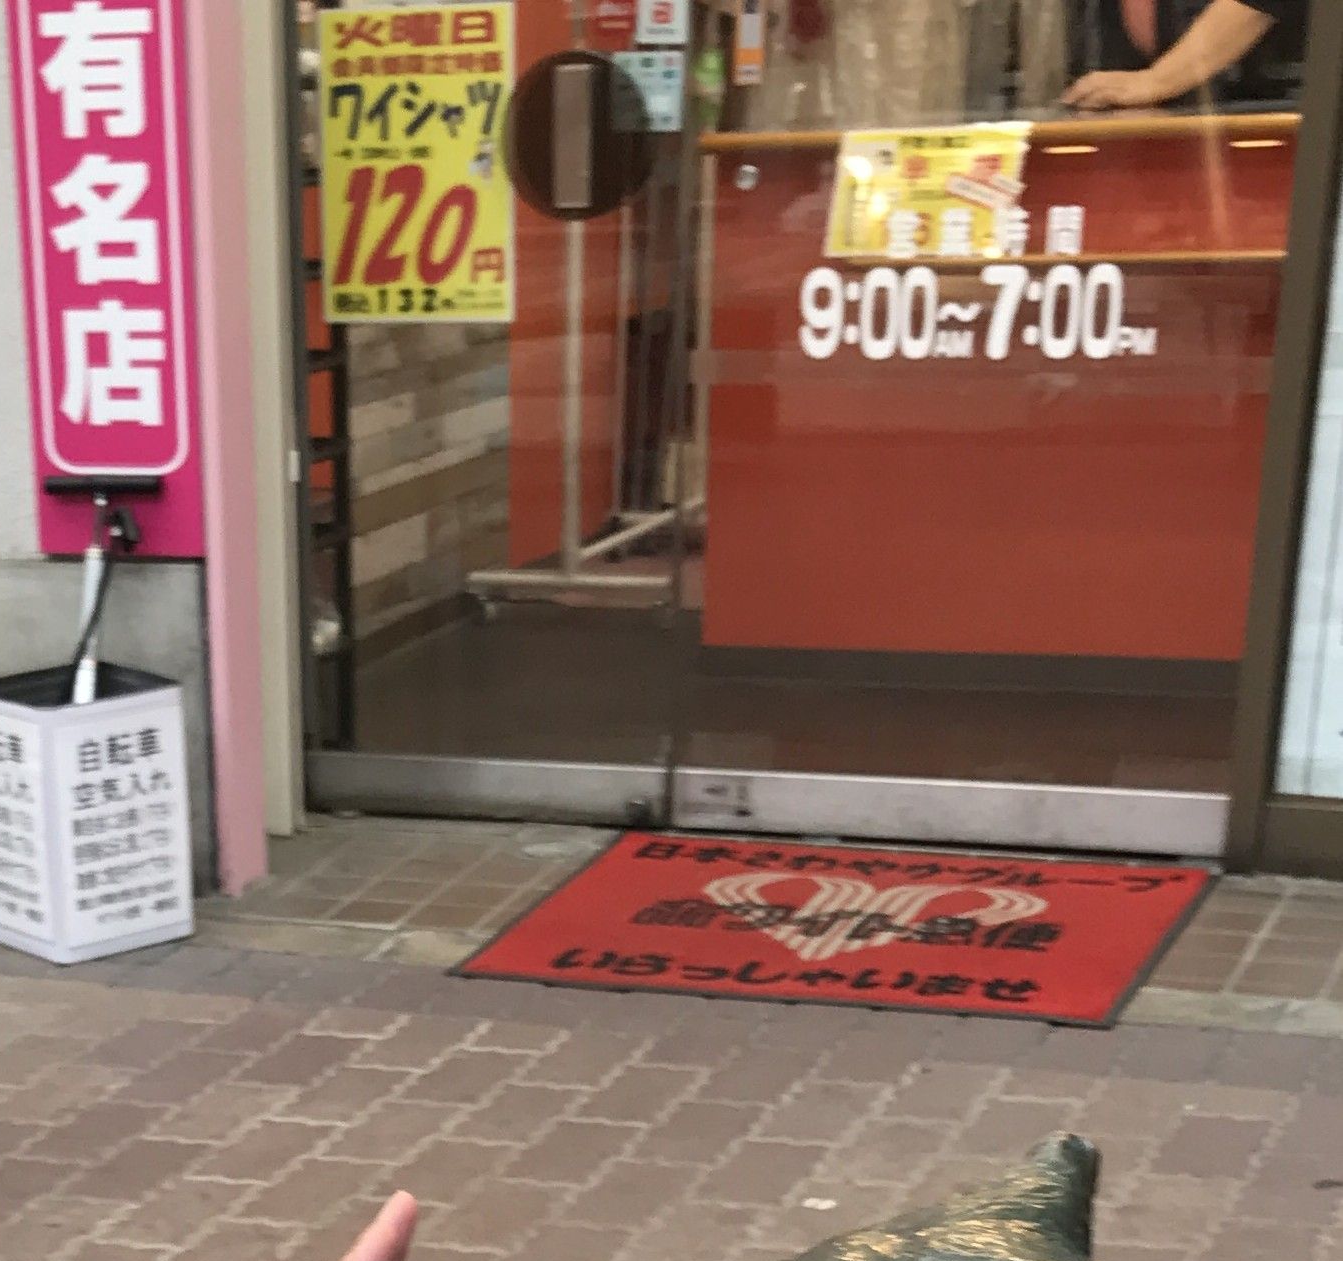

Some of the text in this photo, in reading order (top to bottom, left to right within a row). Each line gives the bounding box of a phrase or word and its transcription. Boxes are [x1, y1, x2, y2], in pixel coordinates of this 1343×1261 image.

[335, 10, 495, 49] 火曜日
[329, 80, 502, 141] ワイシャツ
[38, 1, 166, 427] 有名店
[77, 727, 163, 773] 自転車
[633, 841, 1187, 893] 日本さわやかグループ
[551, 947, 1042, 1003] いらっしゃいませ
